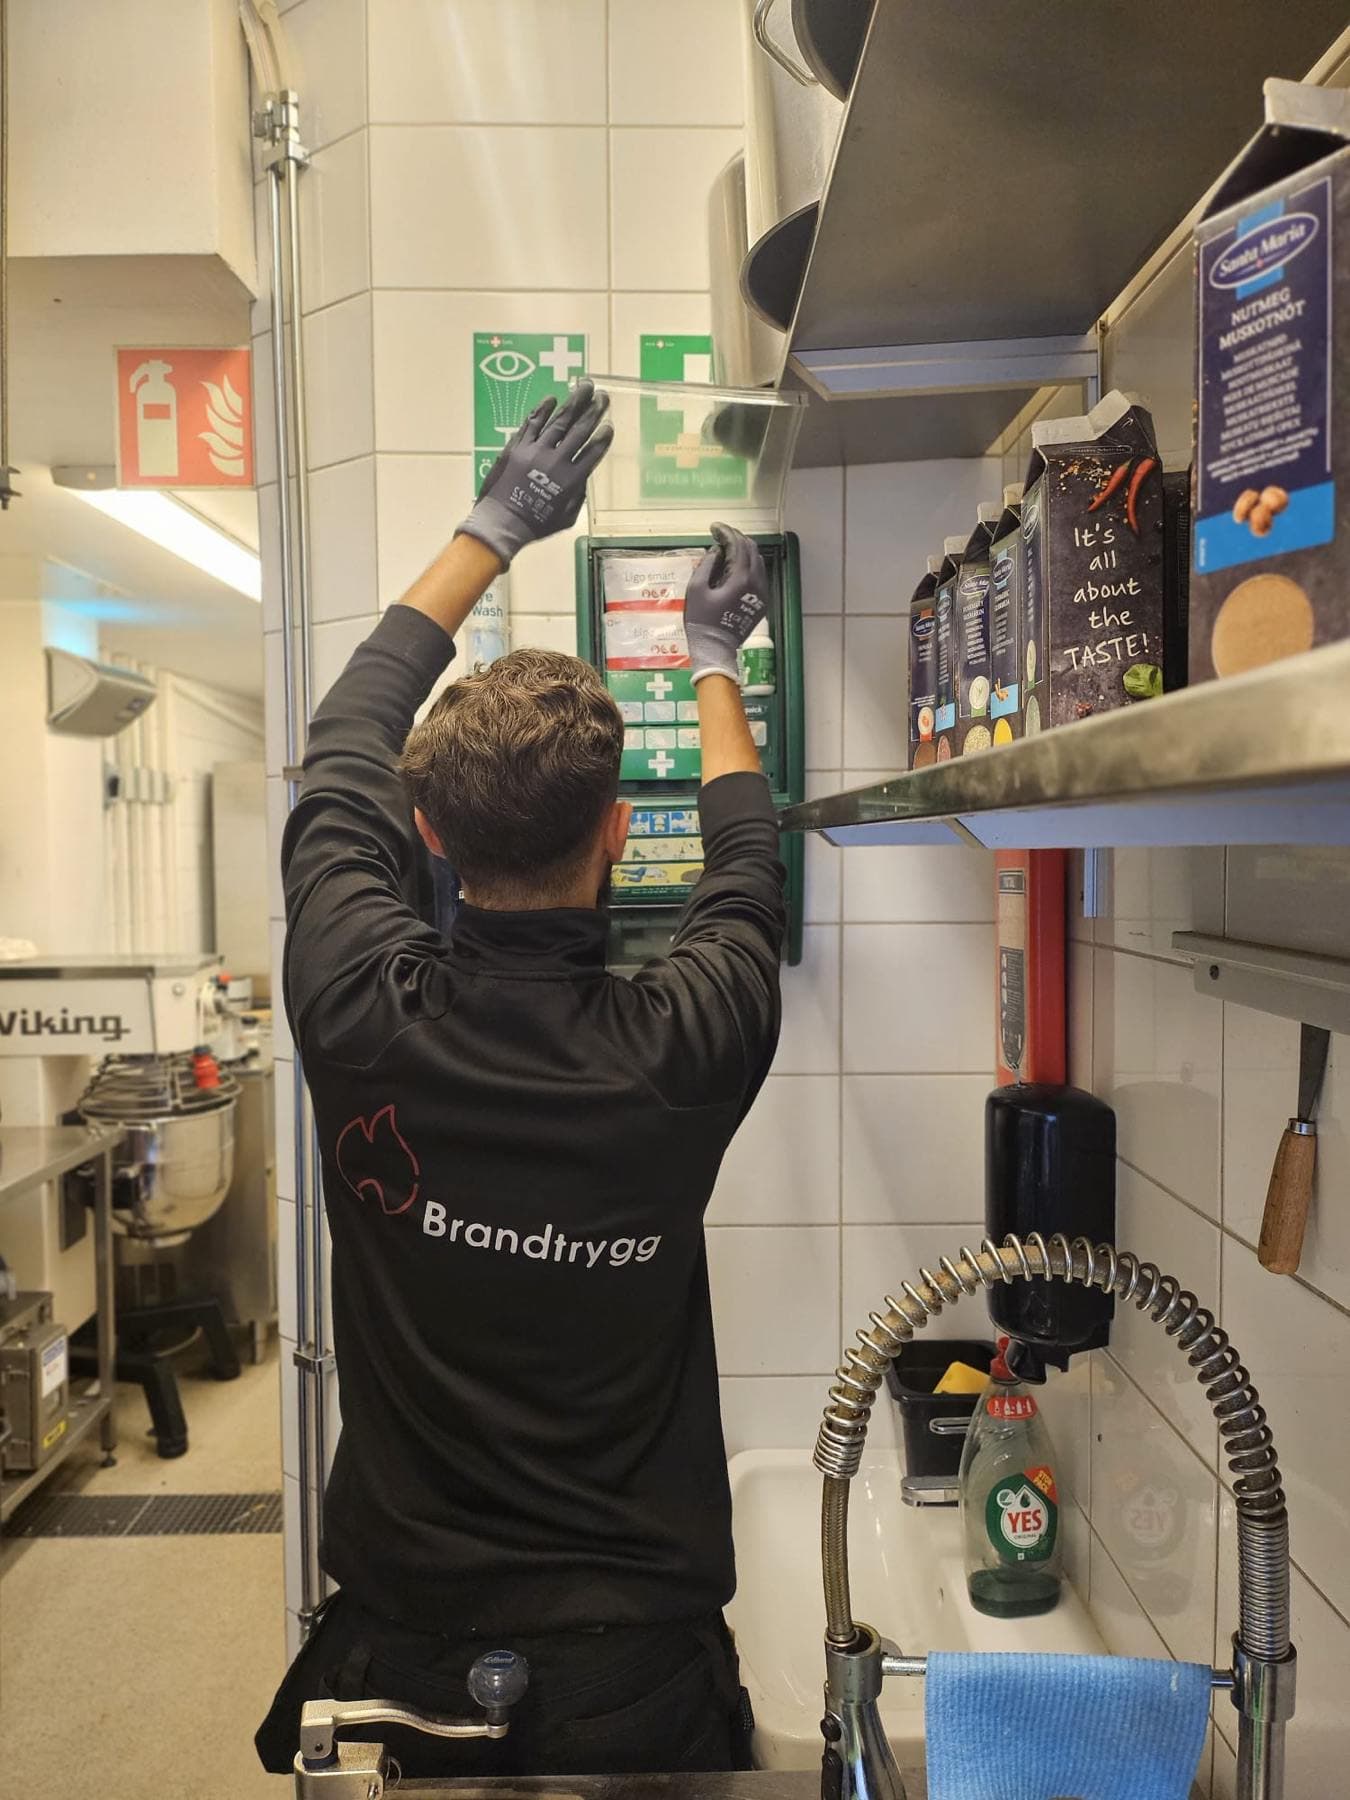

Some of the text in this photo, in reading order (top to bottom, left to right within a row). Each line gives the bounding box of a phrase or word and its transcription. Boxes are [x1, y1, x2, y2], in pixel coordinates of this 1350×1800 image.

[1219, 222, 1306, 277] Santa Maria
[1231, 287, 1291, 327] NUTMEG
[1218, 300, 1306, 350] MUSKOTNÖT
[1074, 523, 1115, 547] It's
[1089, 550, 1116, 570] all
[1073, 577, 1141, 603] about
[1088, 606, 1133, 629] the
[1063, 632, 1150, 671] TASTE!
[0, 1008, 130, 1042] Viking
[423, 1200, 662, 1268] Brandtrygg
[1008, 1509, 1042, 1533] YES
